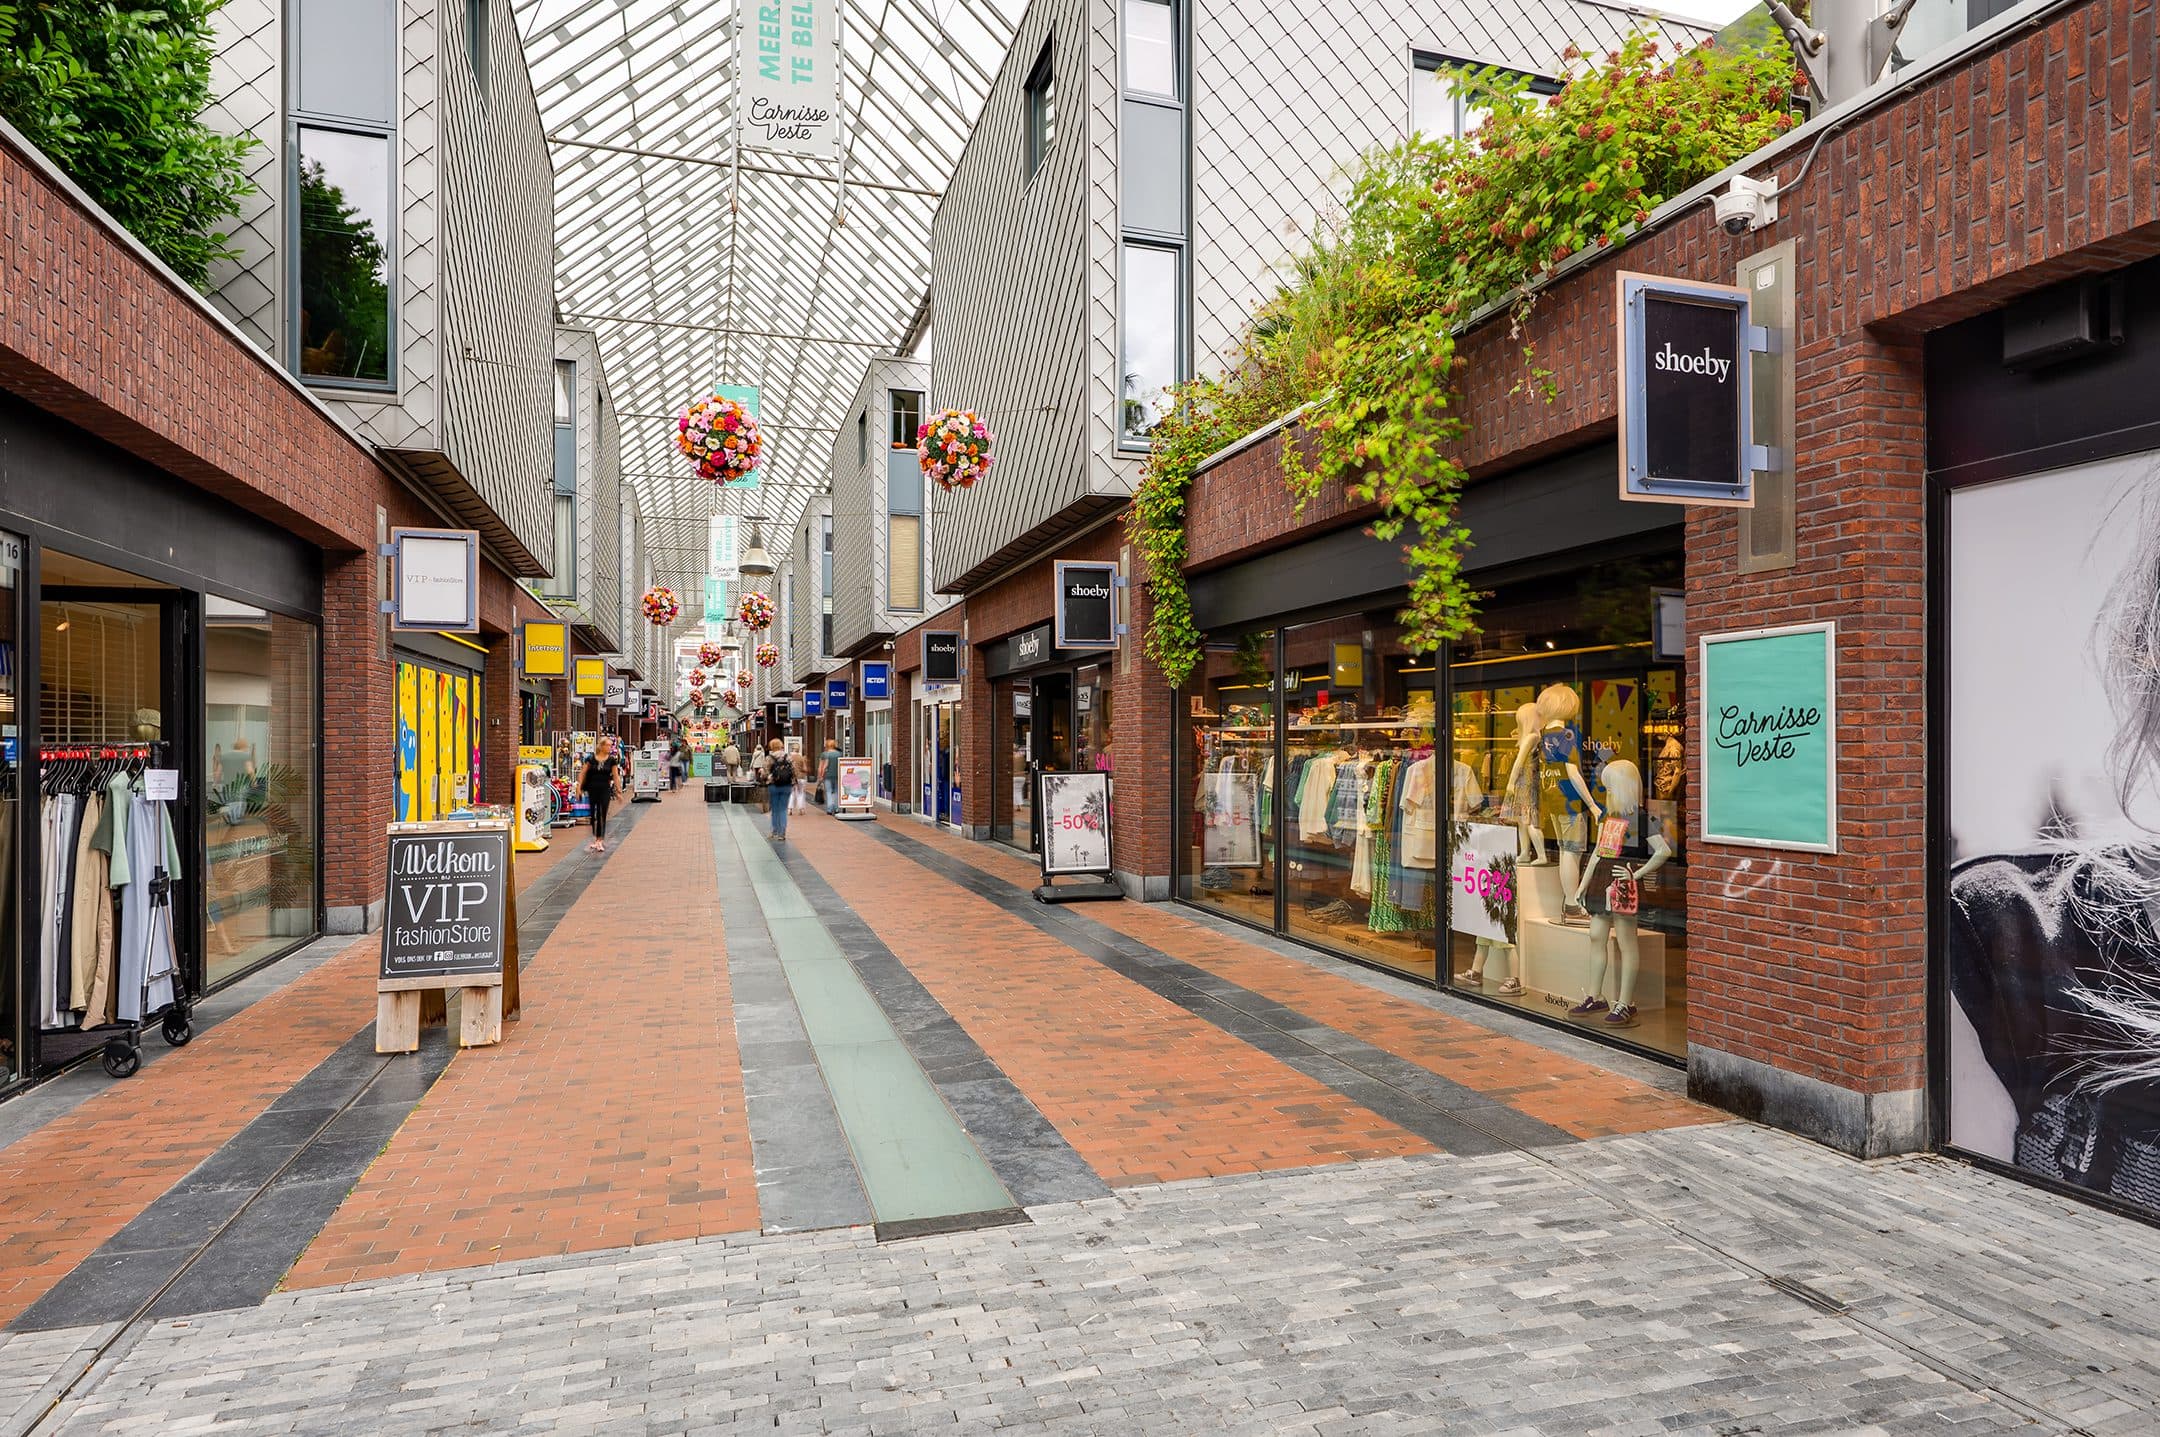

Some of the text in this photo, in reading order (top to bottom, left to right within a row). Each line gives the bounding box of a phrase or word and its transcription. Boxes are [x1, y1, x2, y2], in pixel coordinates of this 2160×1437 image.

[791, 56, 813, 84] TE
[751, 97, 829, 121] Carnisse
[750, 119, 821, 141] Veste
[1655, 342, 1731, 383] shoeby
[7, 543, 18, 559] 16
[407, 575, 428, 584] VIP
[1071, 583, 1110, 599] shoeby
[930, 643, 956, 654] shoeby
[1019, 633, 1039, 657] shoeby
[607, 684, 624, 698] Etos
[1719, 705, 1821, 740] Carnisse
[1582, 736, 1624, 753] shoeby
[1719, 733, 1808, 768] Veste
[1053, 814, 1099, 830] -50%
[394, 841, 495, 875] Welkom
[1464, 852, 1474, 861] tot
[1453, 866, 1513, 902] -50%
[401, 882, 488, 924] VIP
[395, 924, 491, 947] fashionStore
[1544, 993, 1570, 1010] shoeby
